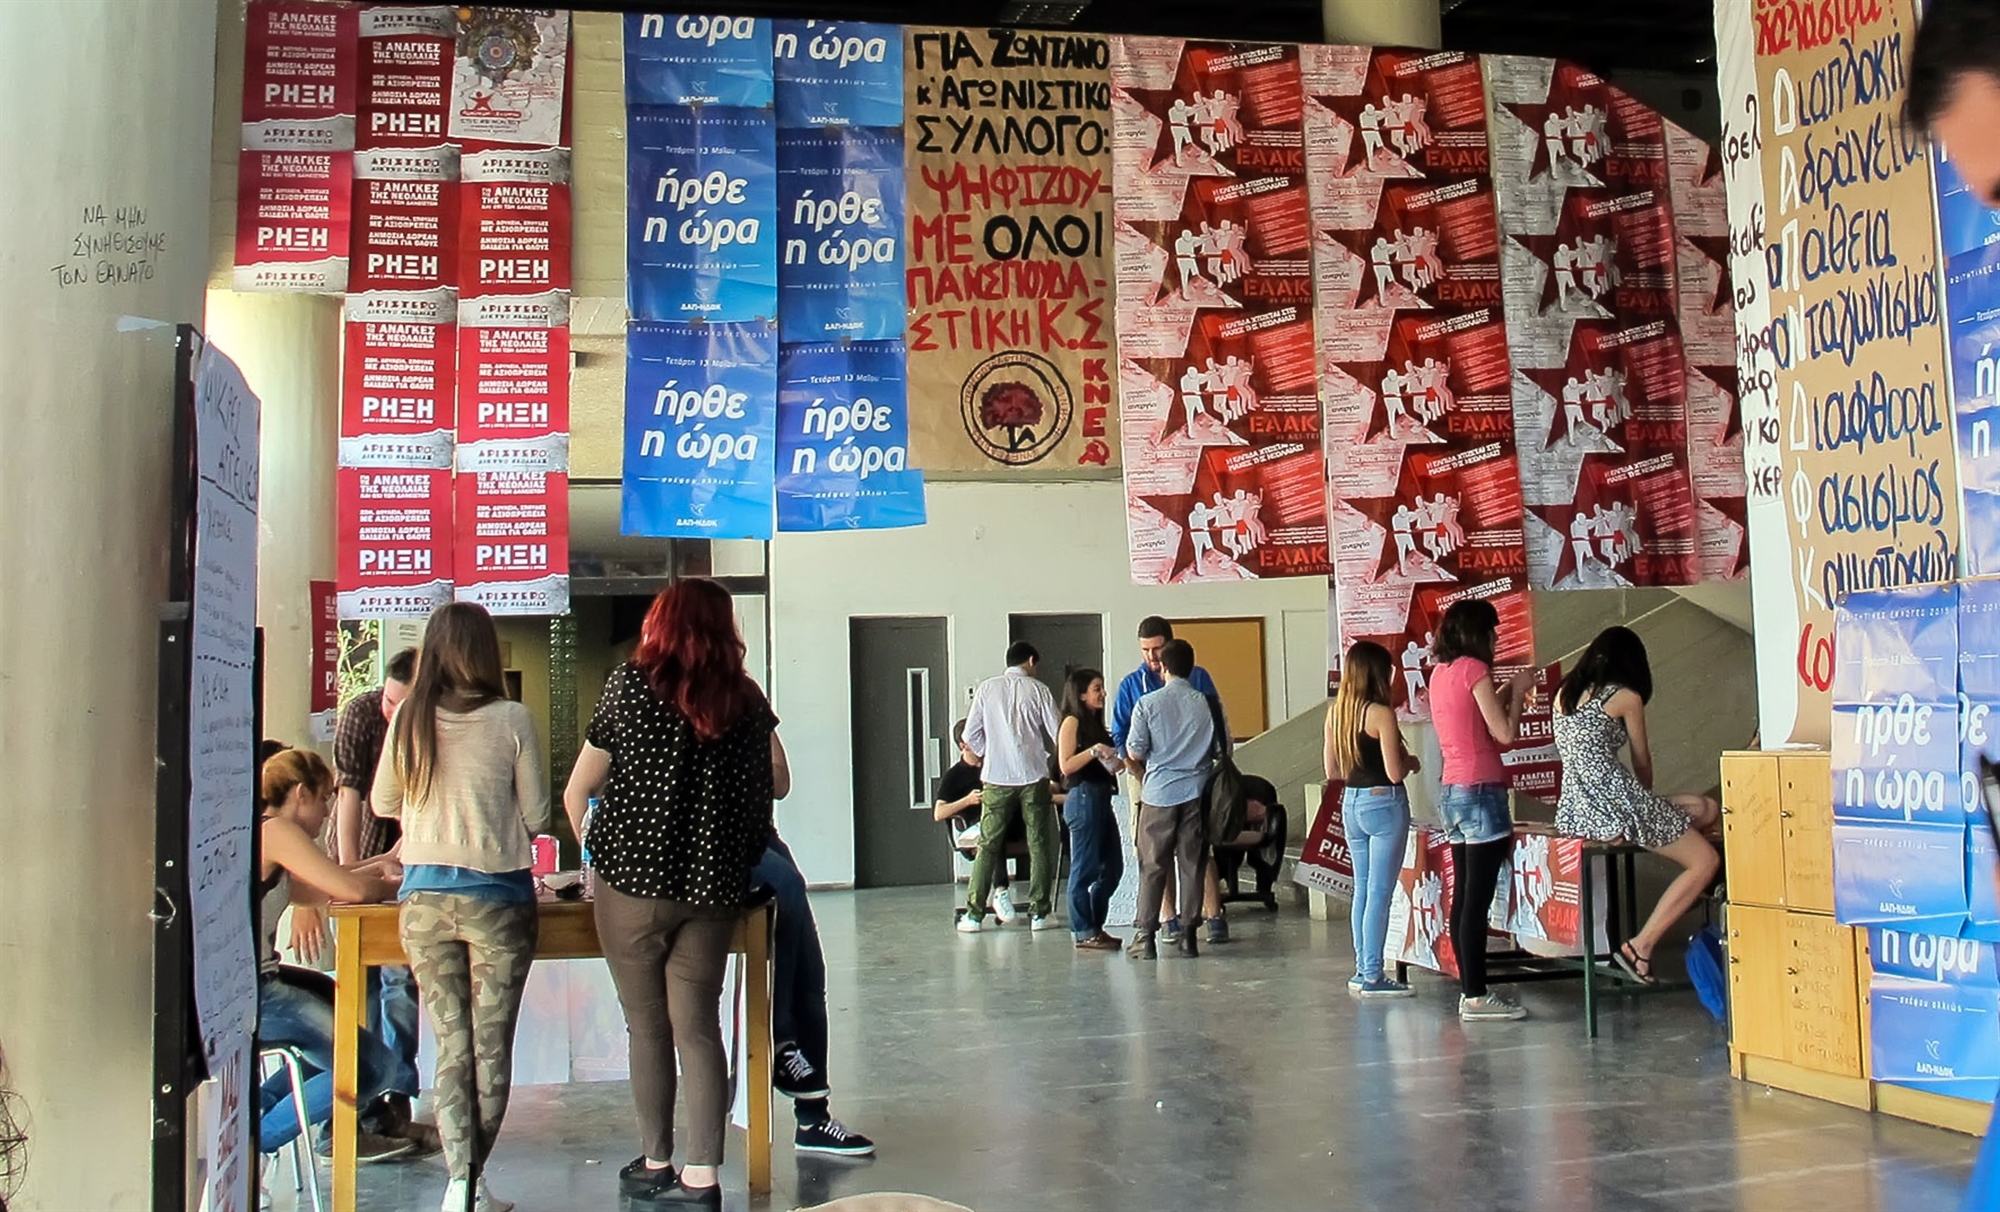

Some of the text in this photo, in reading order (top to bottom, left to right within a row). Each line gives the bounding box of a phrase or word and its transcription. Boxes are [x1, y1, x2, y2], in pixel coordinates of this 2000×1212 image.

[282, 12, 338, 24] ΑΝΑΓΚΕΣ
[386, 41, 440, 52] ΑΝΑΓΚΕΣ
[774, 26, 887, 69] η ώρα
[914, 30, 983, 71] ΓΙΑ
[265, 84, 335, 104] ΡΗΞΗ
[371, 113, 440, 133] ΡΗΞΗ
[916, 115, 1110, 156] ΣΥΛΛΟΓΟ:
[275, 155, 331, 165] ΑΝΑΓΚΕΣ
[384, 182, 439, 193] ΑΝΑΓΚΕΣ
[494, 187, 549, 197] ΑΝΑΓΚΕΣ
[656, 168, 748, 212] ήρθε
[83, 204, 147, 229] ΝΑ ΜΗΝ
[794, 189, 882, 233] ήρθε
[257, 227, 328, 247] ΡΗΞΗ
[643, 210, 760, 253] η ώρα
[913, 211, 1103, 264] ΜΕ ΟΛΟΙ
[784, 229, 896, 272] η ώρα
[367, 254, 438, 276] ΡΗΞΗ
[480, 260, 549, 279] ΡΗΞΗ
[380, 324, 436, 335] ΑΝΑΓΚΕΣ
[493, 330, 548, 340] ΑΝΑΓΚΕΣ
[909, 305, 1031, 352] ΣΤΙΚΗ
[362, 398, 434, 419] ΡΗΞΗ
[478, 403, 548, 423] ΡΗΞΗ
[653, 380, 748, 425] ήρθε
[802, 398, 892, 441] ήρθε
[640, 423, 758, 468] η ώρα
[1971, 419, 1990, 459] η
[791, 435, 905, 479] η ώρα
[374, 474, 431, 485] ΑΝΑΓΚΕΣ
[491, 470, 546, 481] ΑΝΑΓΚΕΣ
[359, 550, 431, 570] ΡΗΞΗ
[476, 545, 547, 566] ΡΗΞΗ
[1520, 721, 1552, 736] ΗΞΗ
[1853, 691, 1934, 757] ήρθε
[1846, 767, 1865, 808] η
[1874, 754, 1945, 821] ώρα
